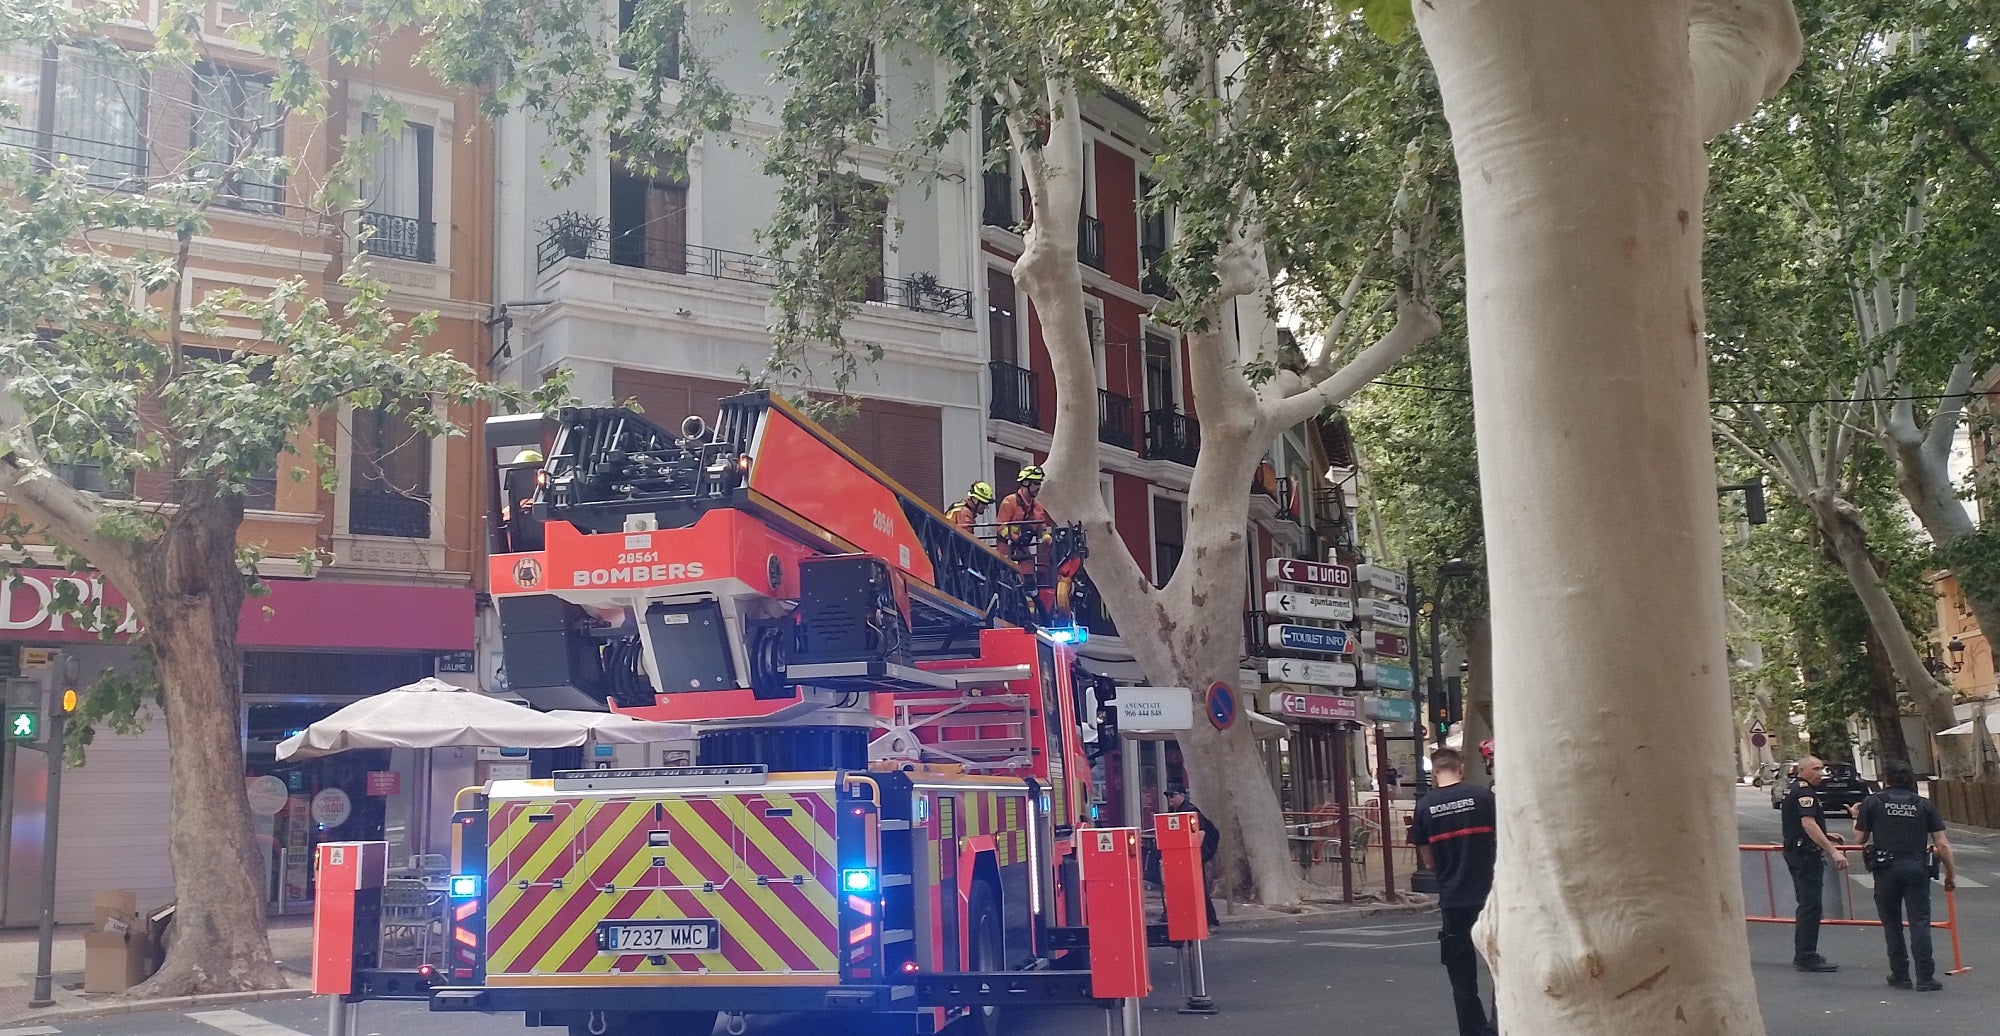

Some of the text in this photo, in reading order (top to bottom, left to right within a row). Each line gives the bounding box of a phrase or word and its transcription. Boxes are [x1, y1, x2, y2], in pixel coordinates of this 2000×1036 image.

[618, 551, 658, 564] 28561
[573, 562, 704, 586] BOMBERS
[1320, 567, 1347, 584] UNED
[1310, 597, 1350, 609] ajuntament
[1291, 632, 1344, 646] TOURIST INFO
[1338, 699, 1355, 707] casa
[1310, 705, 1356, 717] de la cultura
[1430, 798, 1475, 814] BOMBERS
[1887, 809, 1915, 817] LOCAL
[621, 929, 663, 946] 7237
[671, 929, 703, 945] MMC
